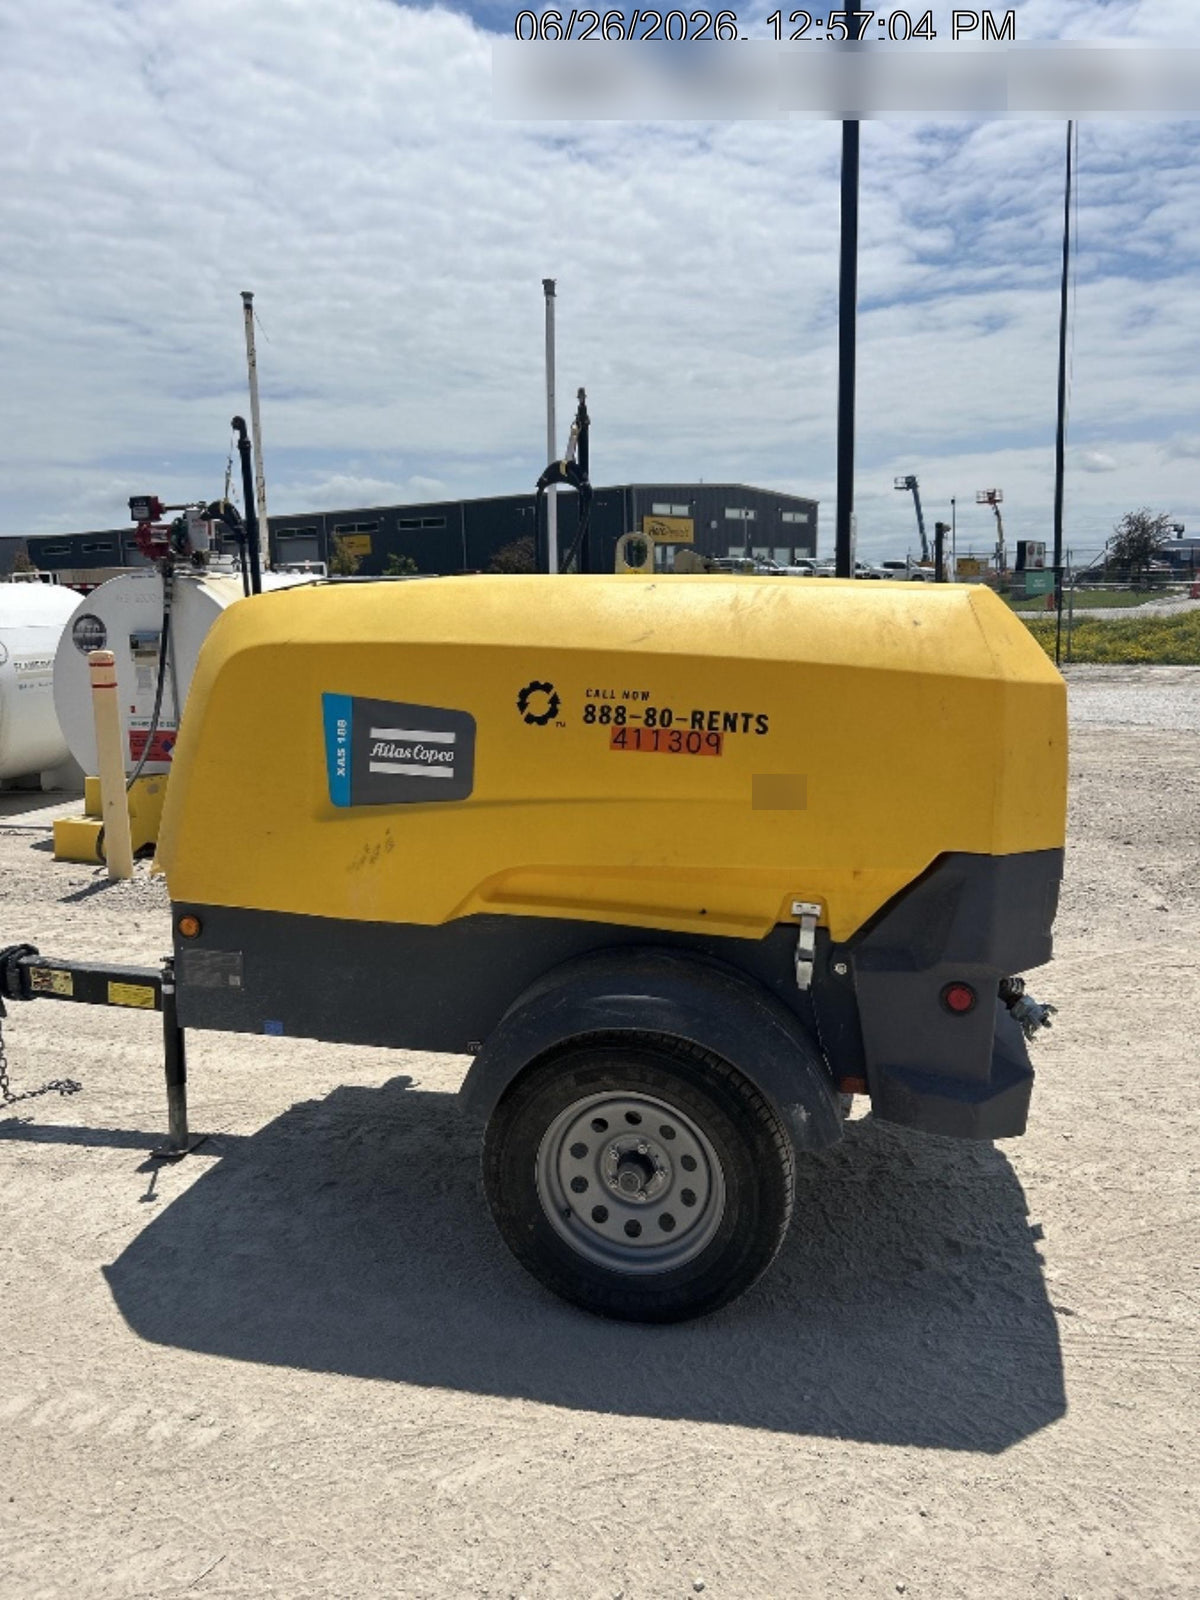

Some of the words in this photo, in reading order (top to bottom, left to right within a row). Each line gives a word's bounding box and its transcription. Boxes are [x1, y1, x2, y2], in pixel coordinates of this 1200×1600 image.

[586, 688, 616, 700] CALL
[622, 689, 650, 701] NOW
[583, 703, 769, 735] 888-80-RENTS
[369, 742, 412, 760] Atlas
[413, 744, 454, 764] Copco
[612, 727, 721, 755] 411309
[336, 748, 346, 776] XAS
